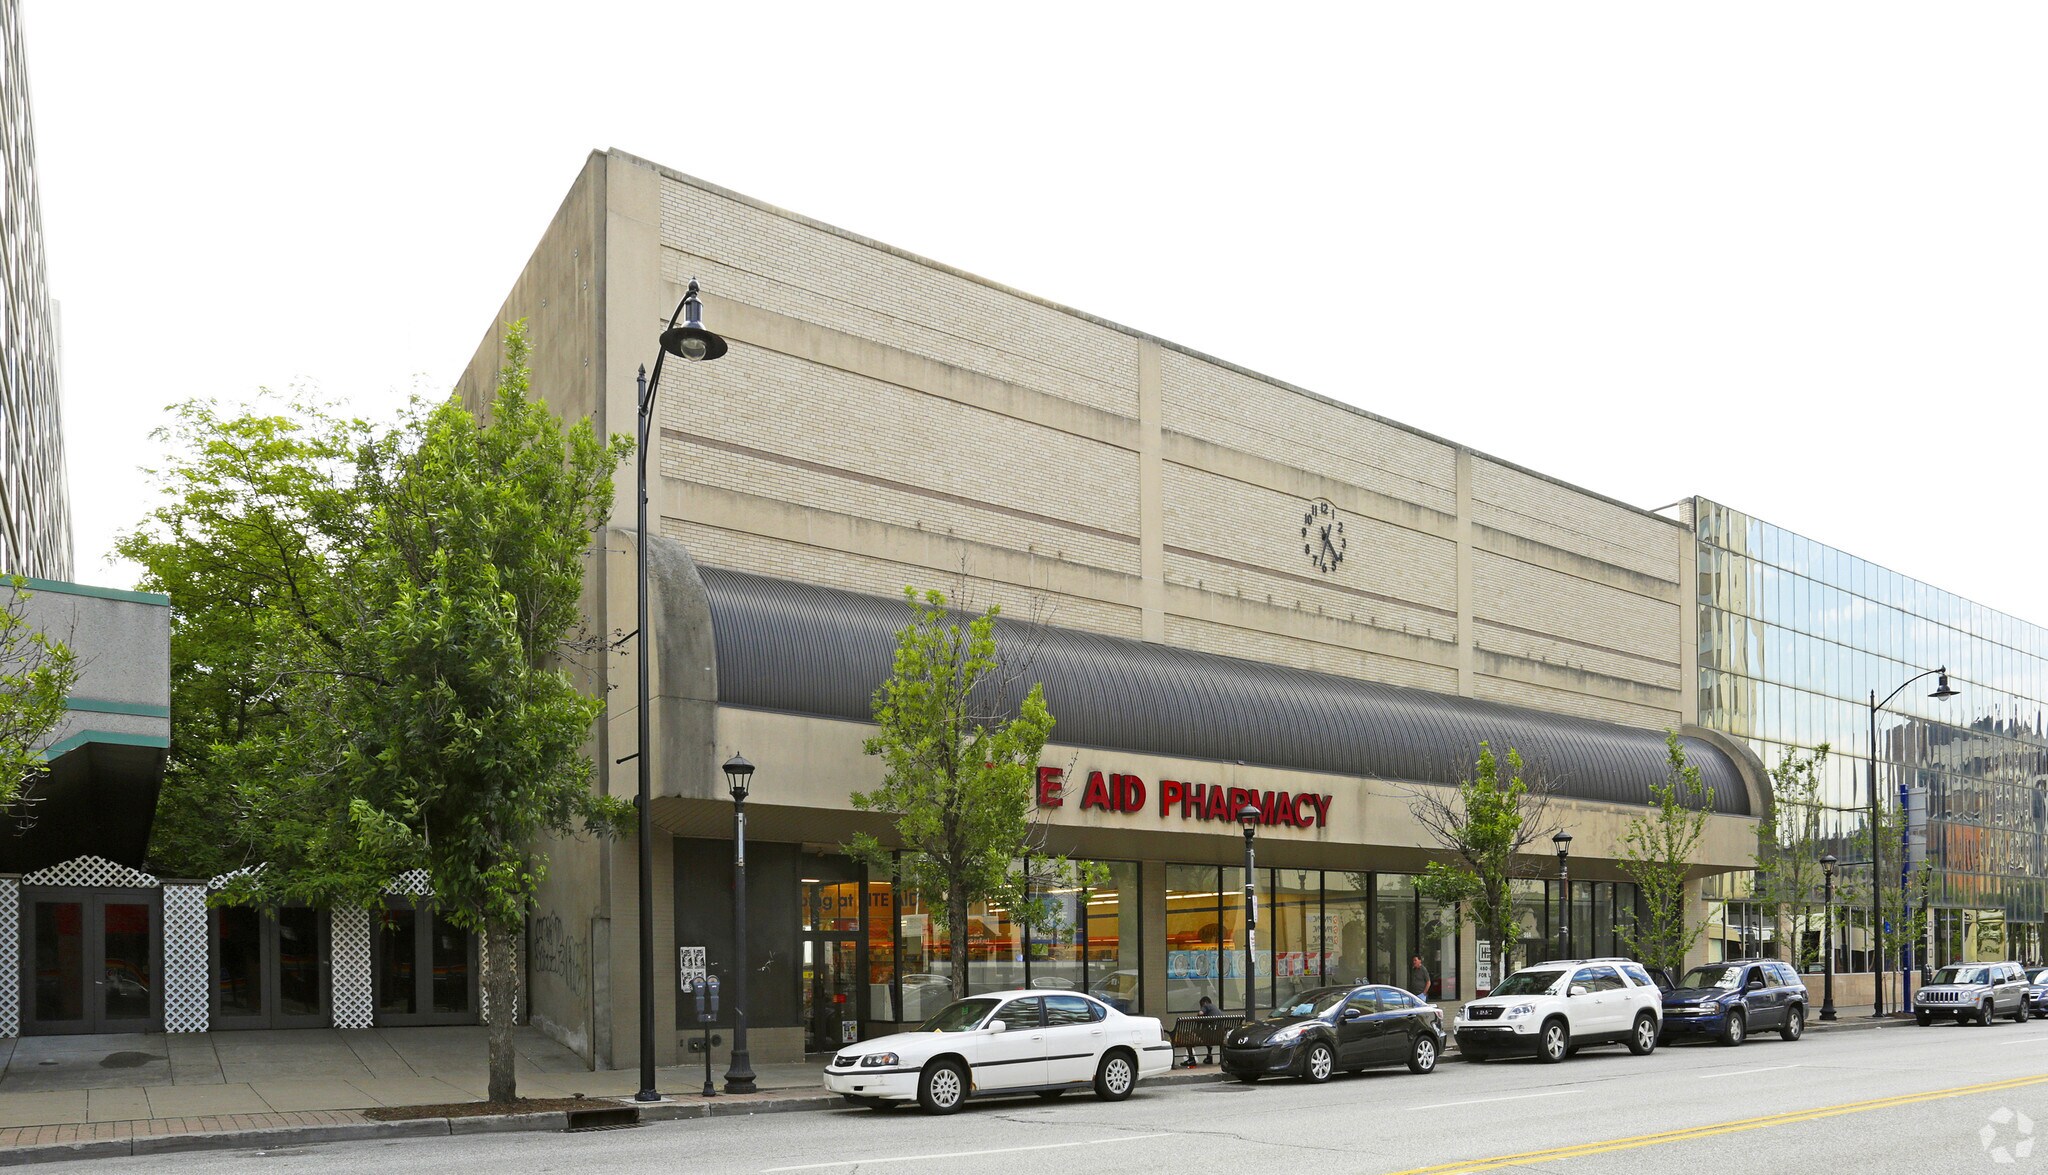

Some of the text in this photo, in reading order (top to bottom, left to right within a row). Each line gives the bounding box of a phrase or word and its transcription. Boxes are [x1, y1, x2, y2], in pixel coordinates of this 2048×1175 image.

[1311, 504, 1317, 517] 11
[1321, 502, 1328, 515] 12
[1304, 513, 1312, 525] 10
[1301, 527, 1307, 538] 9
[1338, 522, 1343, 533] 2
[1305, 544, 1310, 554] 8
[1341, 538, 1346, 549] 3
[1313, 555, 1318, 566] 7
[1338, 552, 1343, 562] 4
[1322, 563, 1327, 573] 6
[1331, 560, 1337, 572] 5
[1080, 771, 1147, 812] AID
[1160, 780, 1333, 828] PHARMACY
[869, 892, 889, 907] ITE
